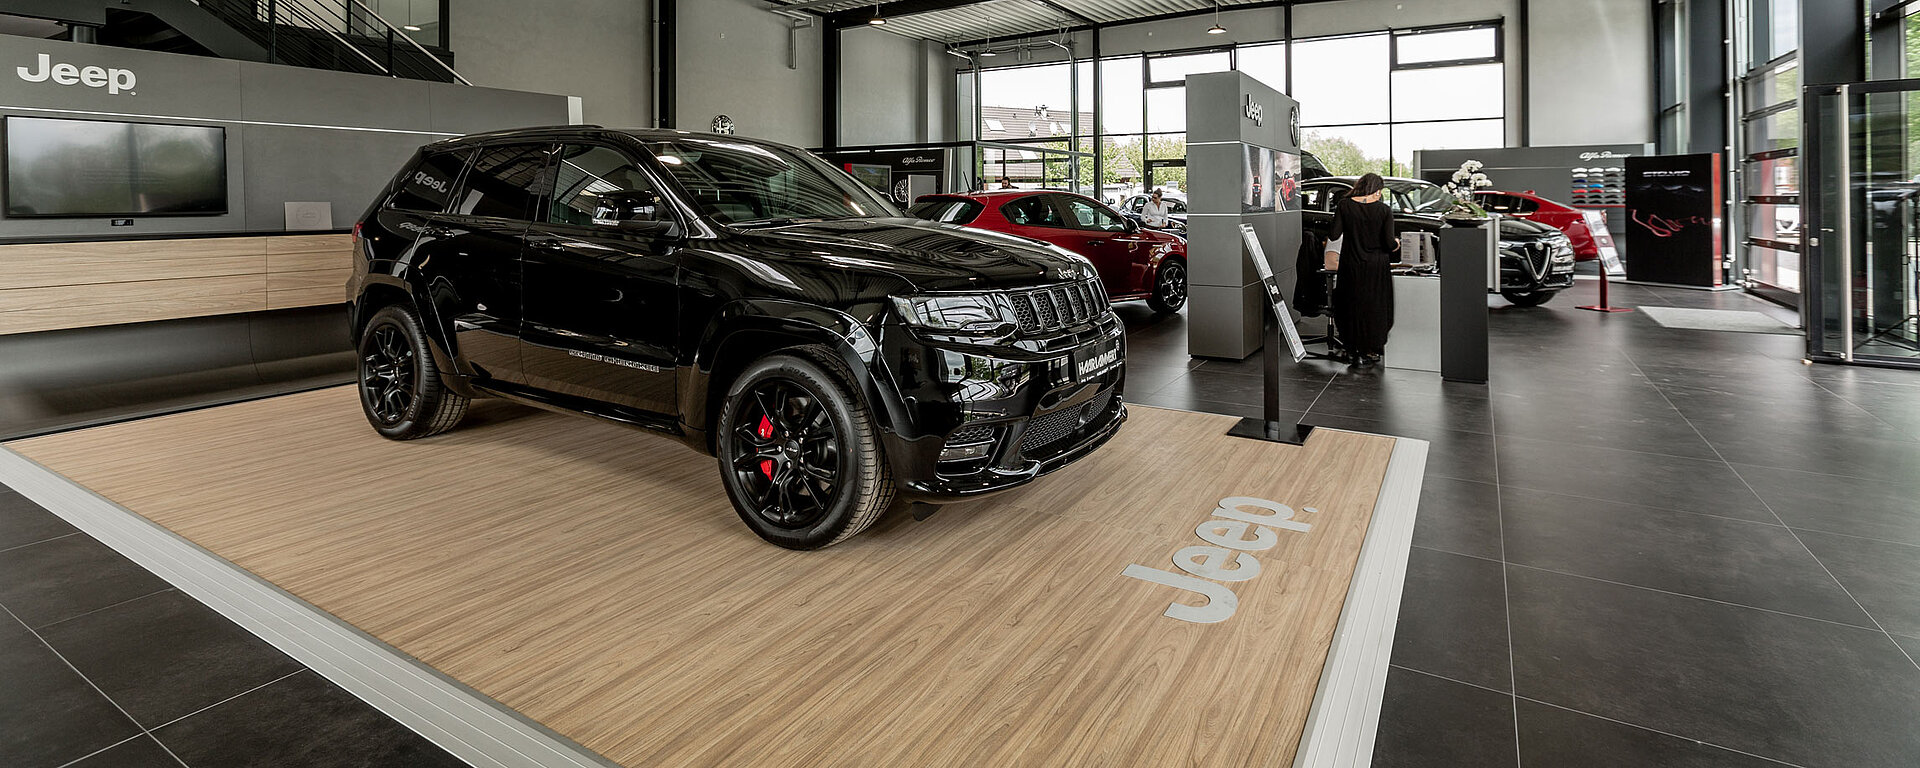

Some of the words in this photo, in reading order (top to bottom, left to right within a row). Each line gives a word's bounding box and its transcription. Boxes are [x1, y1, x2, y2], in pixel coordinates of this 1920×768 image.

[1245, 93, 1263, 127] Jeep
[1579, 151, 1601, 161] Alfa
[1600, 151, 1631, 159] Romeo
[902, 157, 915, 166] Alfa
